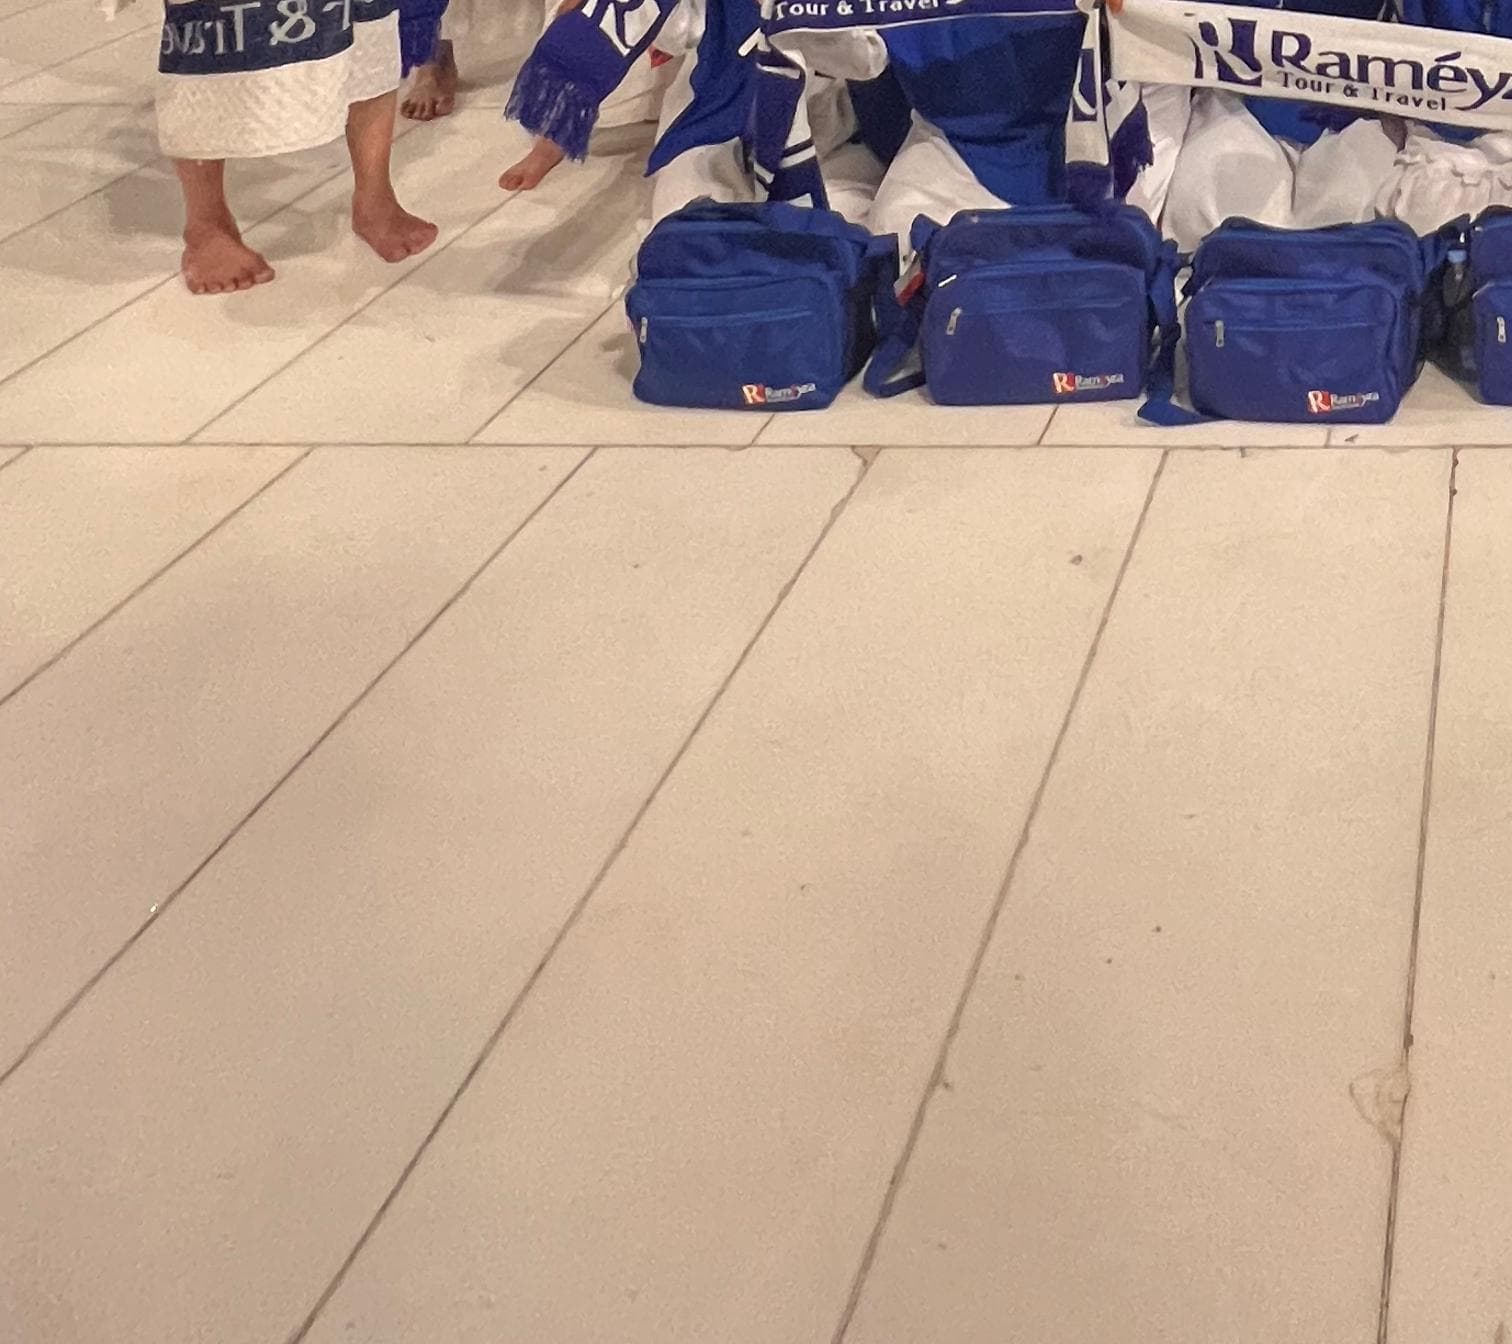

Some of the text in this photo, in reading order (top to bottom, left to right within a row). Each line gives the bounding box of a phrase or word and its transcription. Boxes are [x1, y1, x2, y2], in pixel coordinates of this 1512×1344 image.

[1276, 69, 1448, 112] Tour & Travel
